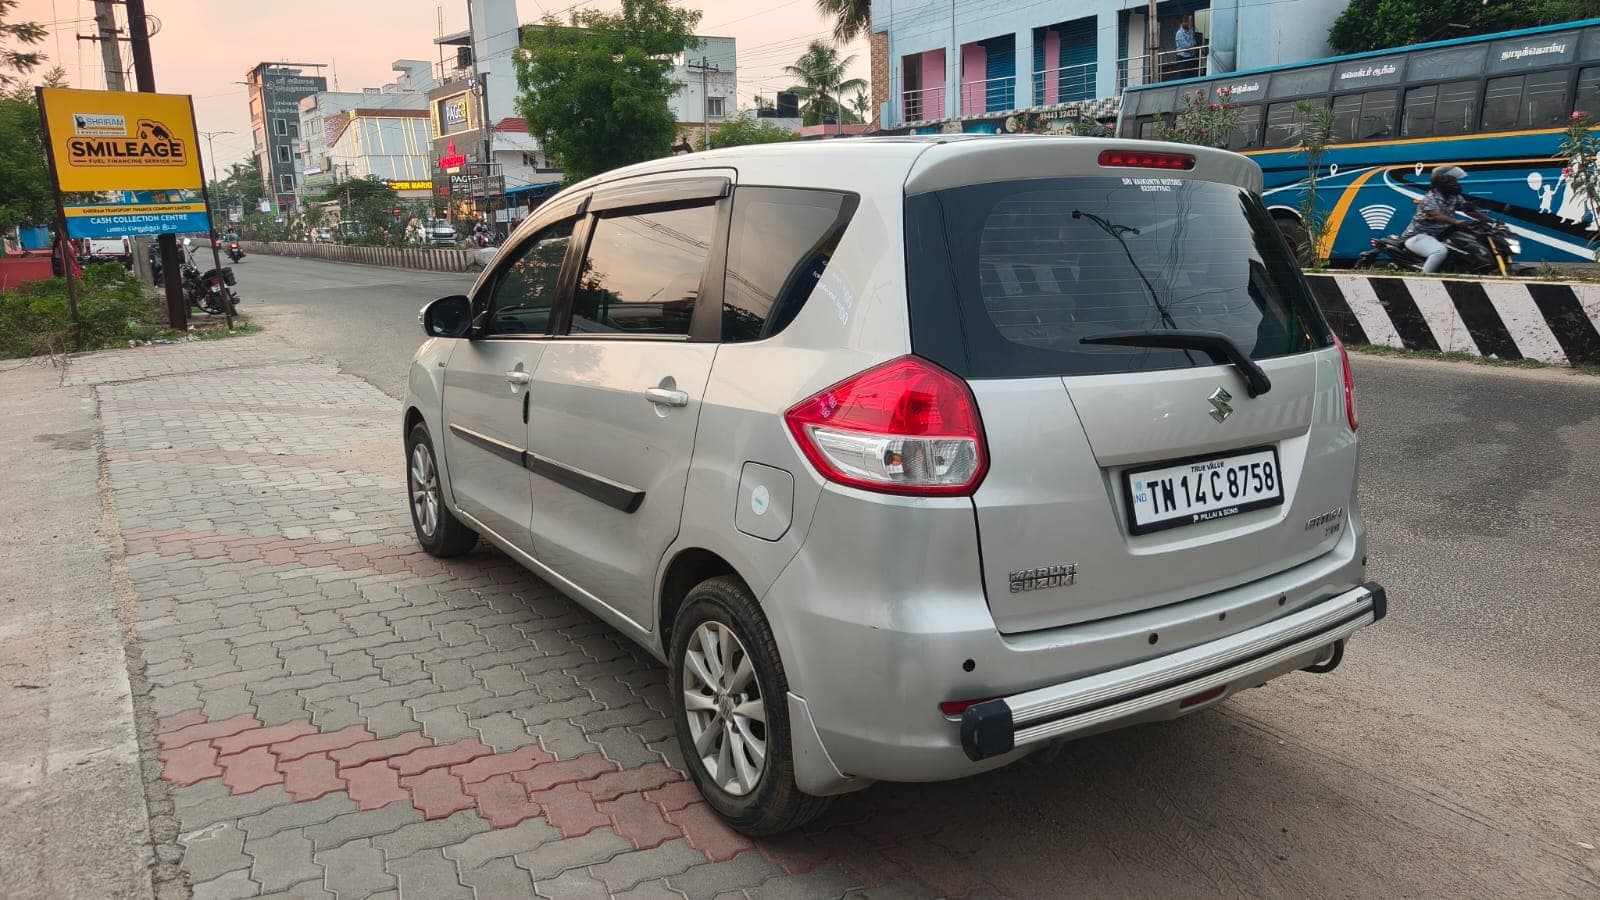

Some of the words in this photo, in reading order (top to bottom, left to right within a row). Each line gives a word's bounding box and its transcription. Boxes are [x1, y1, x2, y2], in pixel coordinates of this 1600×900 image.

[86, 118, 124, 126] SHRIRAM
[71, 141, 183, 158] SMILEAGE
[113, 215, 160, 223] COLLECTION
[1191, 464, 1206, 473] TRUE
[1207, 461, 1224, 470] VALUE
[1200, 512, 1218, 521] PILLAI
[1224, 508, 1238, 516] SONS
[1010, 562, 1078, 582] MARUTI
[1010, 574, 1078, 593] SUZUKI
